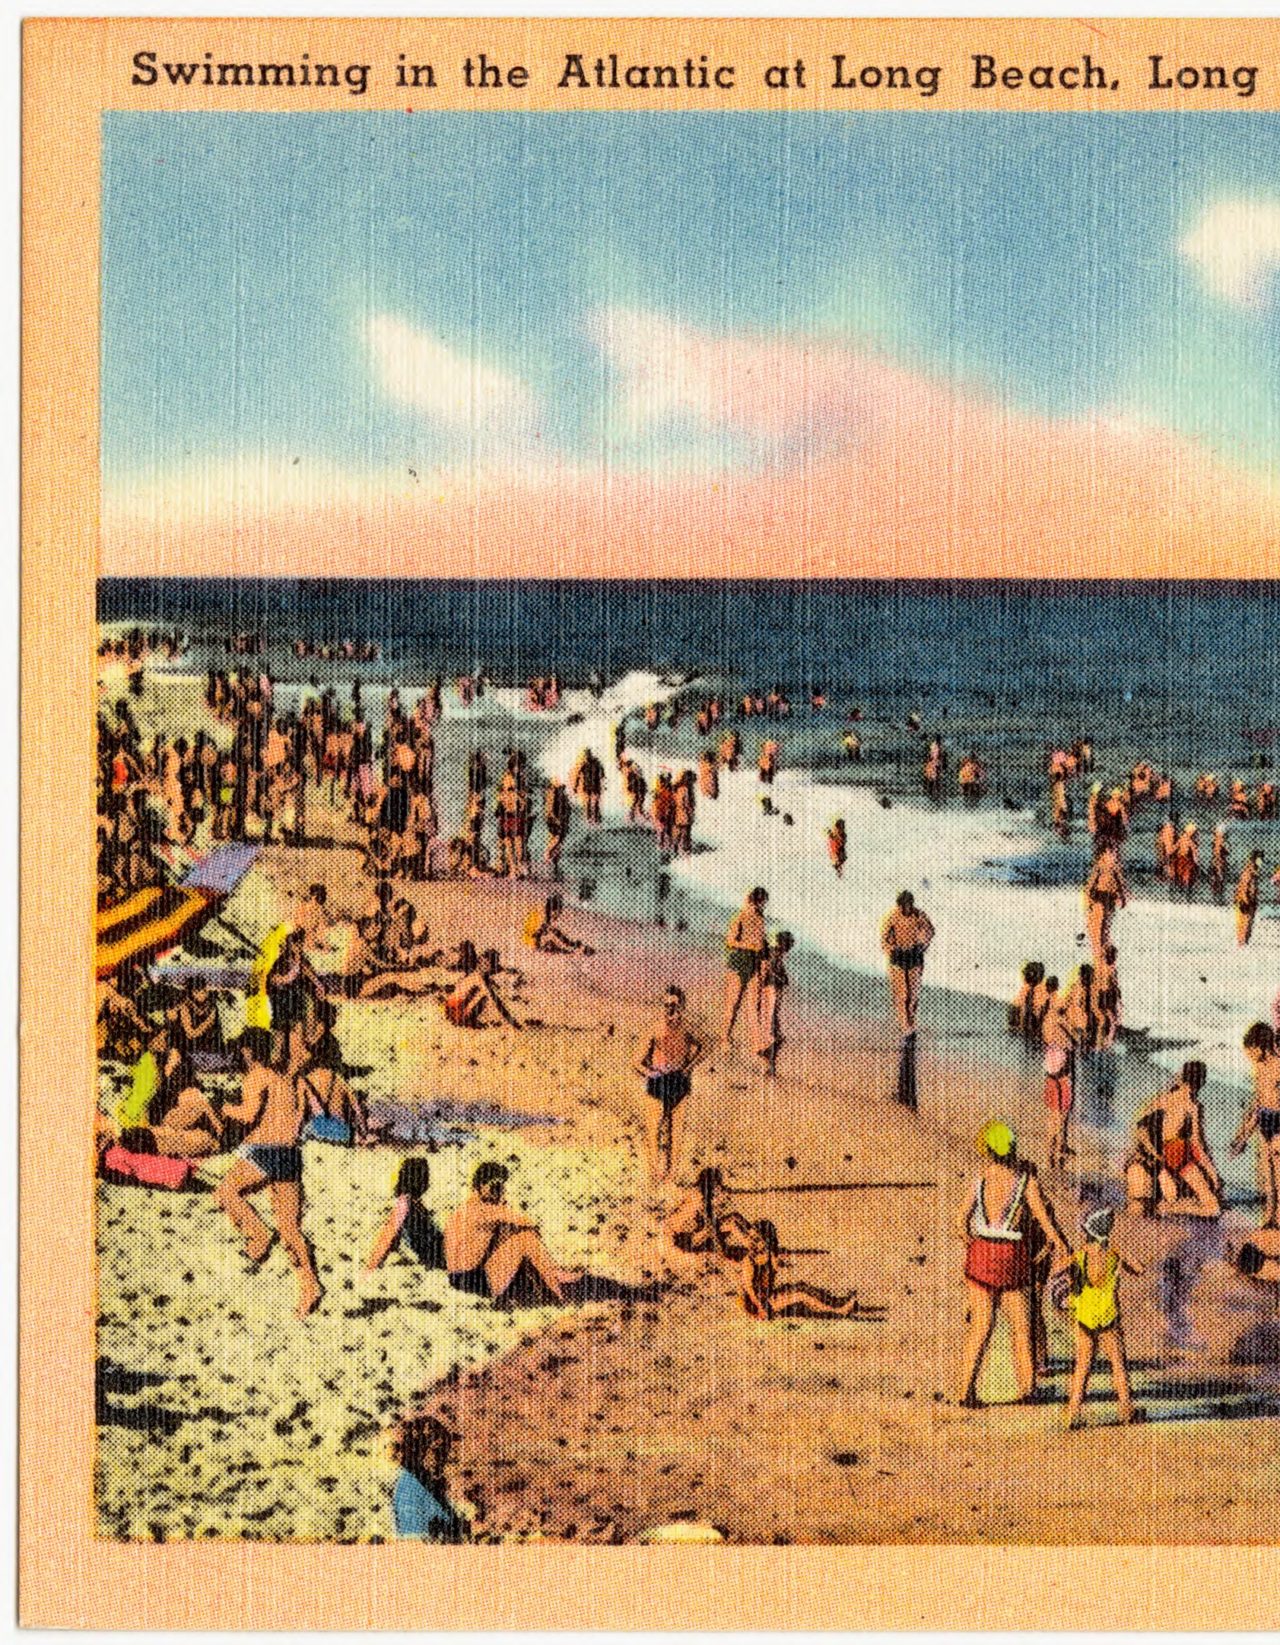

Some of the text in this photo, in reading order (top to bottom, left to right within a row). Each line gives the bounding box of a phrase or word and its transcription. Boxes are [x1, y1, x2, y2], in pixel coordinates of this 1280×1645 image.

[131, 51, 371, 95] Swimming
[395, 53, 438, 88] in
[463, 53, 529, 89] the
[557, 54, 735, 89] Atlantic
[764, 59, 806, 89] at
[831, 54, 942, 97] Long
[970, 54, 1119, 91] Beach,
[1148, 55, 1259, 98] Long
